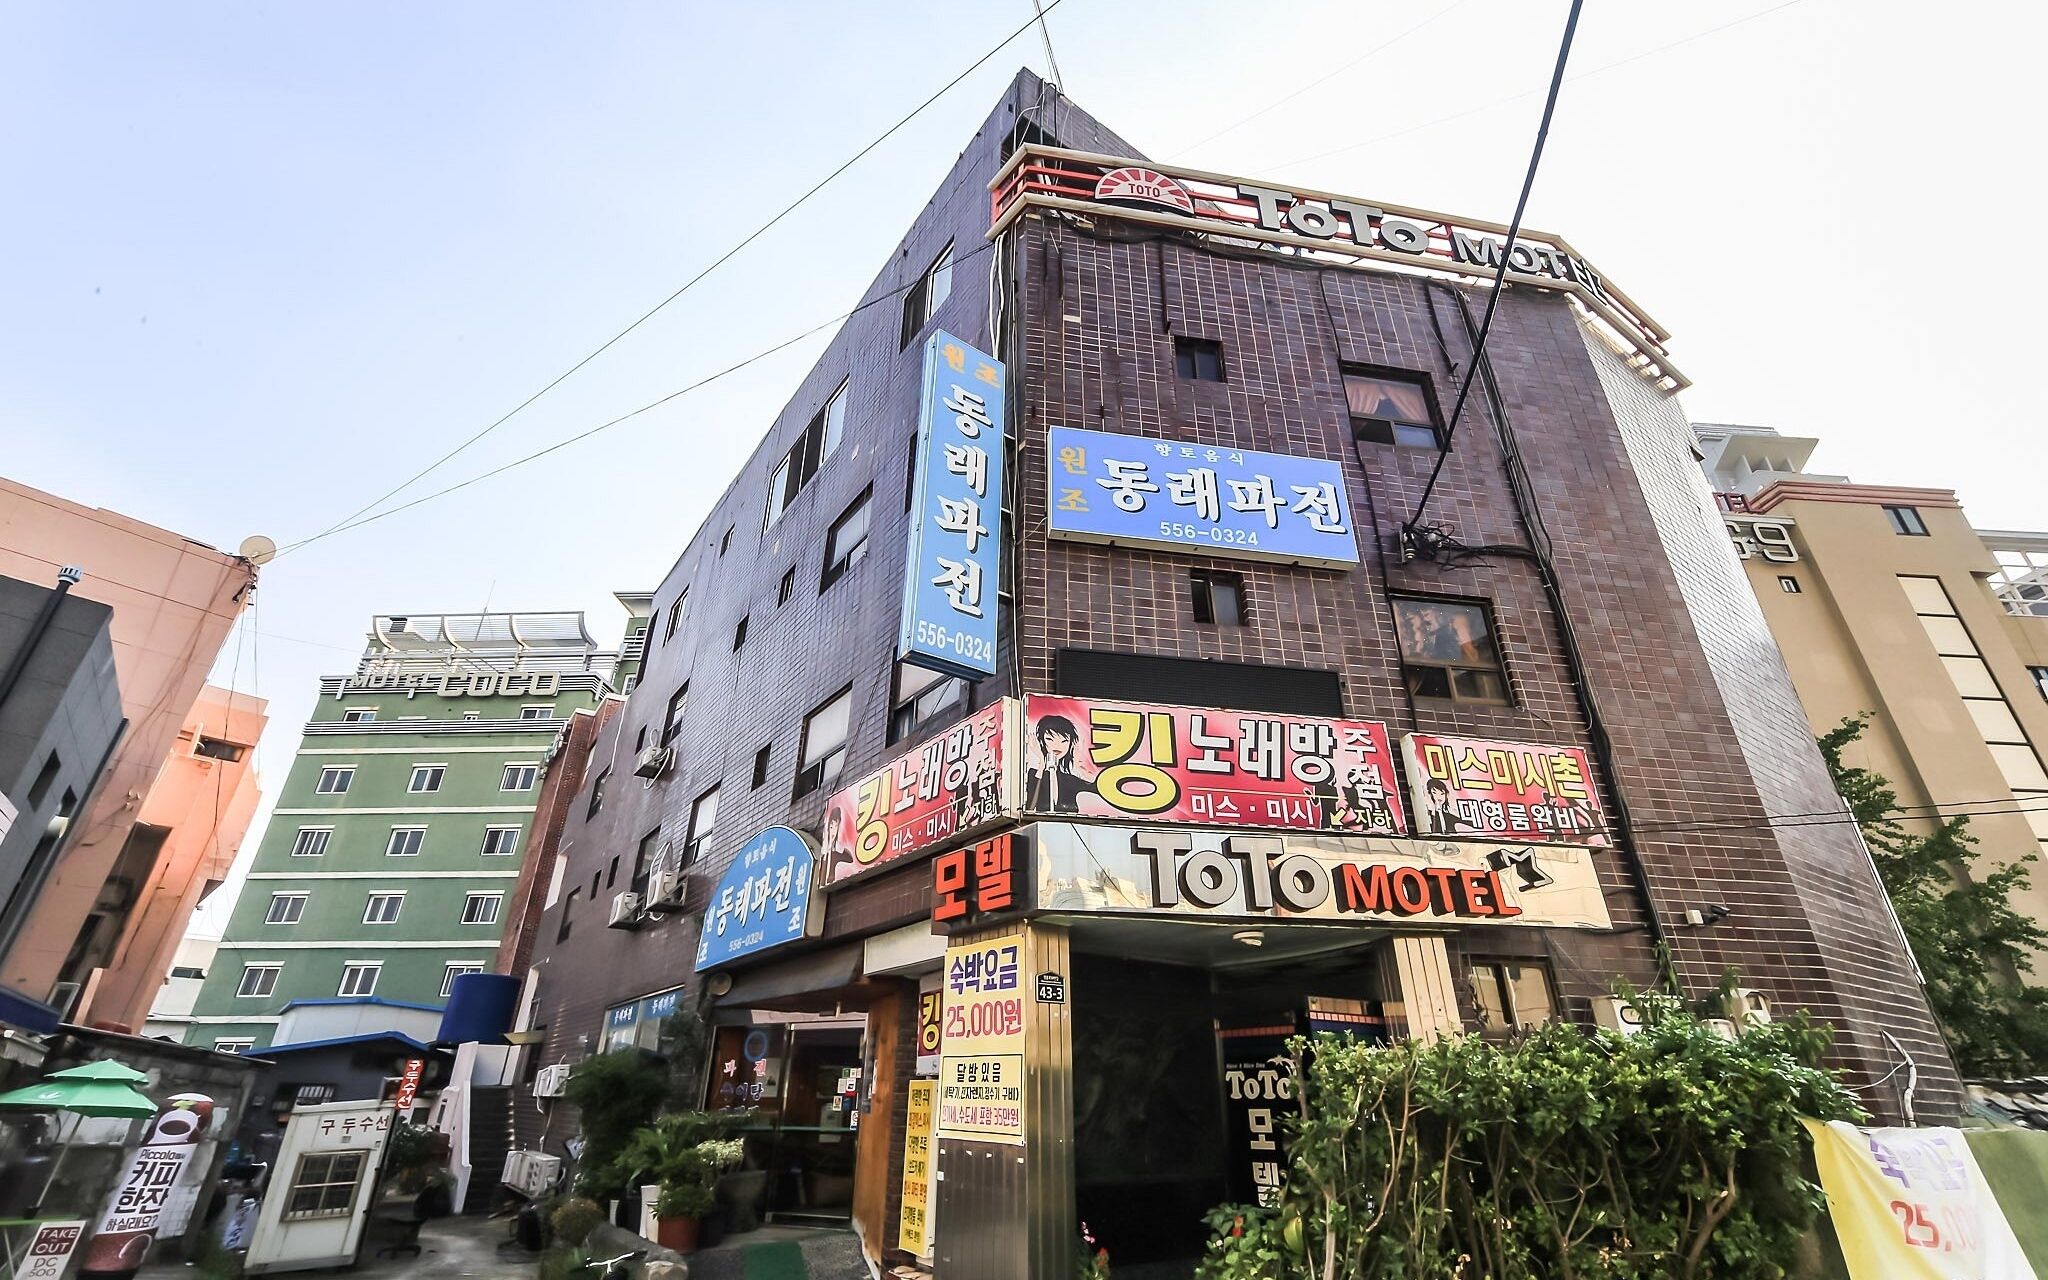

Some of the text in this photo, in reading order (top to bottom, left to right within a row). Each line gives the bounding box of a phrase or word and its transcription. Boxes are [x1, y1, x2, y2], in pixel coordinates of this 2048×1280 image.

[1128, 183, 1160, 198] TOTO
[1153, 443, 1245, 466] 향토음식
[1056, 446, 1090, 512] 원조
[930, 383, 995, 620] 동래파전
[1095, 457, 1349, 534] 동래파전
[1159, 521, 1259, 546] 556-0324
[917, 619, 992, 663] 556-0324
[351, 671, 562, 698] MOTEL COCO
[1342, 727, 1384, 801] 주점
[1424, 744, 1589, 800] 미스미시촌
[973, 794, 998, 818] 지하
[1354, 807, 1393, 830] 지하
[934, 833, 1014, 922] 모텔
[1332, 863, 1523, 918] MOTEL
[716, 856, 795, 936] 동래파전
[949, 945, 1018, 995] 숙박요금
[1040, 986, 1063, 1000] 43-3
[922, 992, 941, 1050] 킹
[945, 998, 1022, 1038] 25,000원
[397, 1060, 422, 1109] 구두수선
[127, 1161, 183, 1187] 커피
[114, 1187, 169, 1214] 한잔
[41, 1228, 77, 1239] TAKE
[105, 1215, 158, 1232] 하실래요?
[35, 1242, 70, 1254] OUT
[28, 1268, 57, 1277] 500
[34, 1257, 58, 1268] DC
